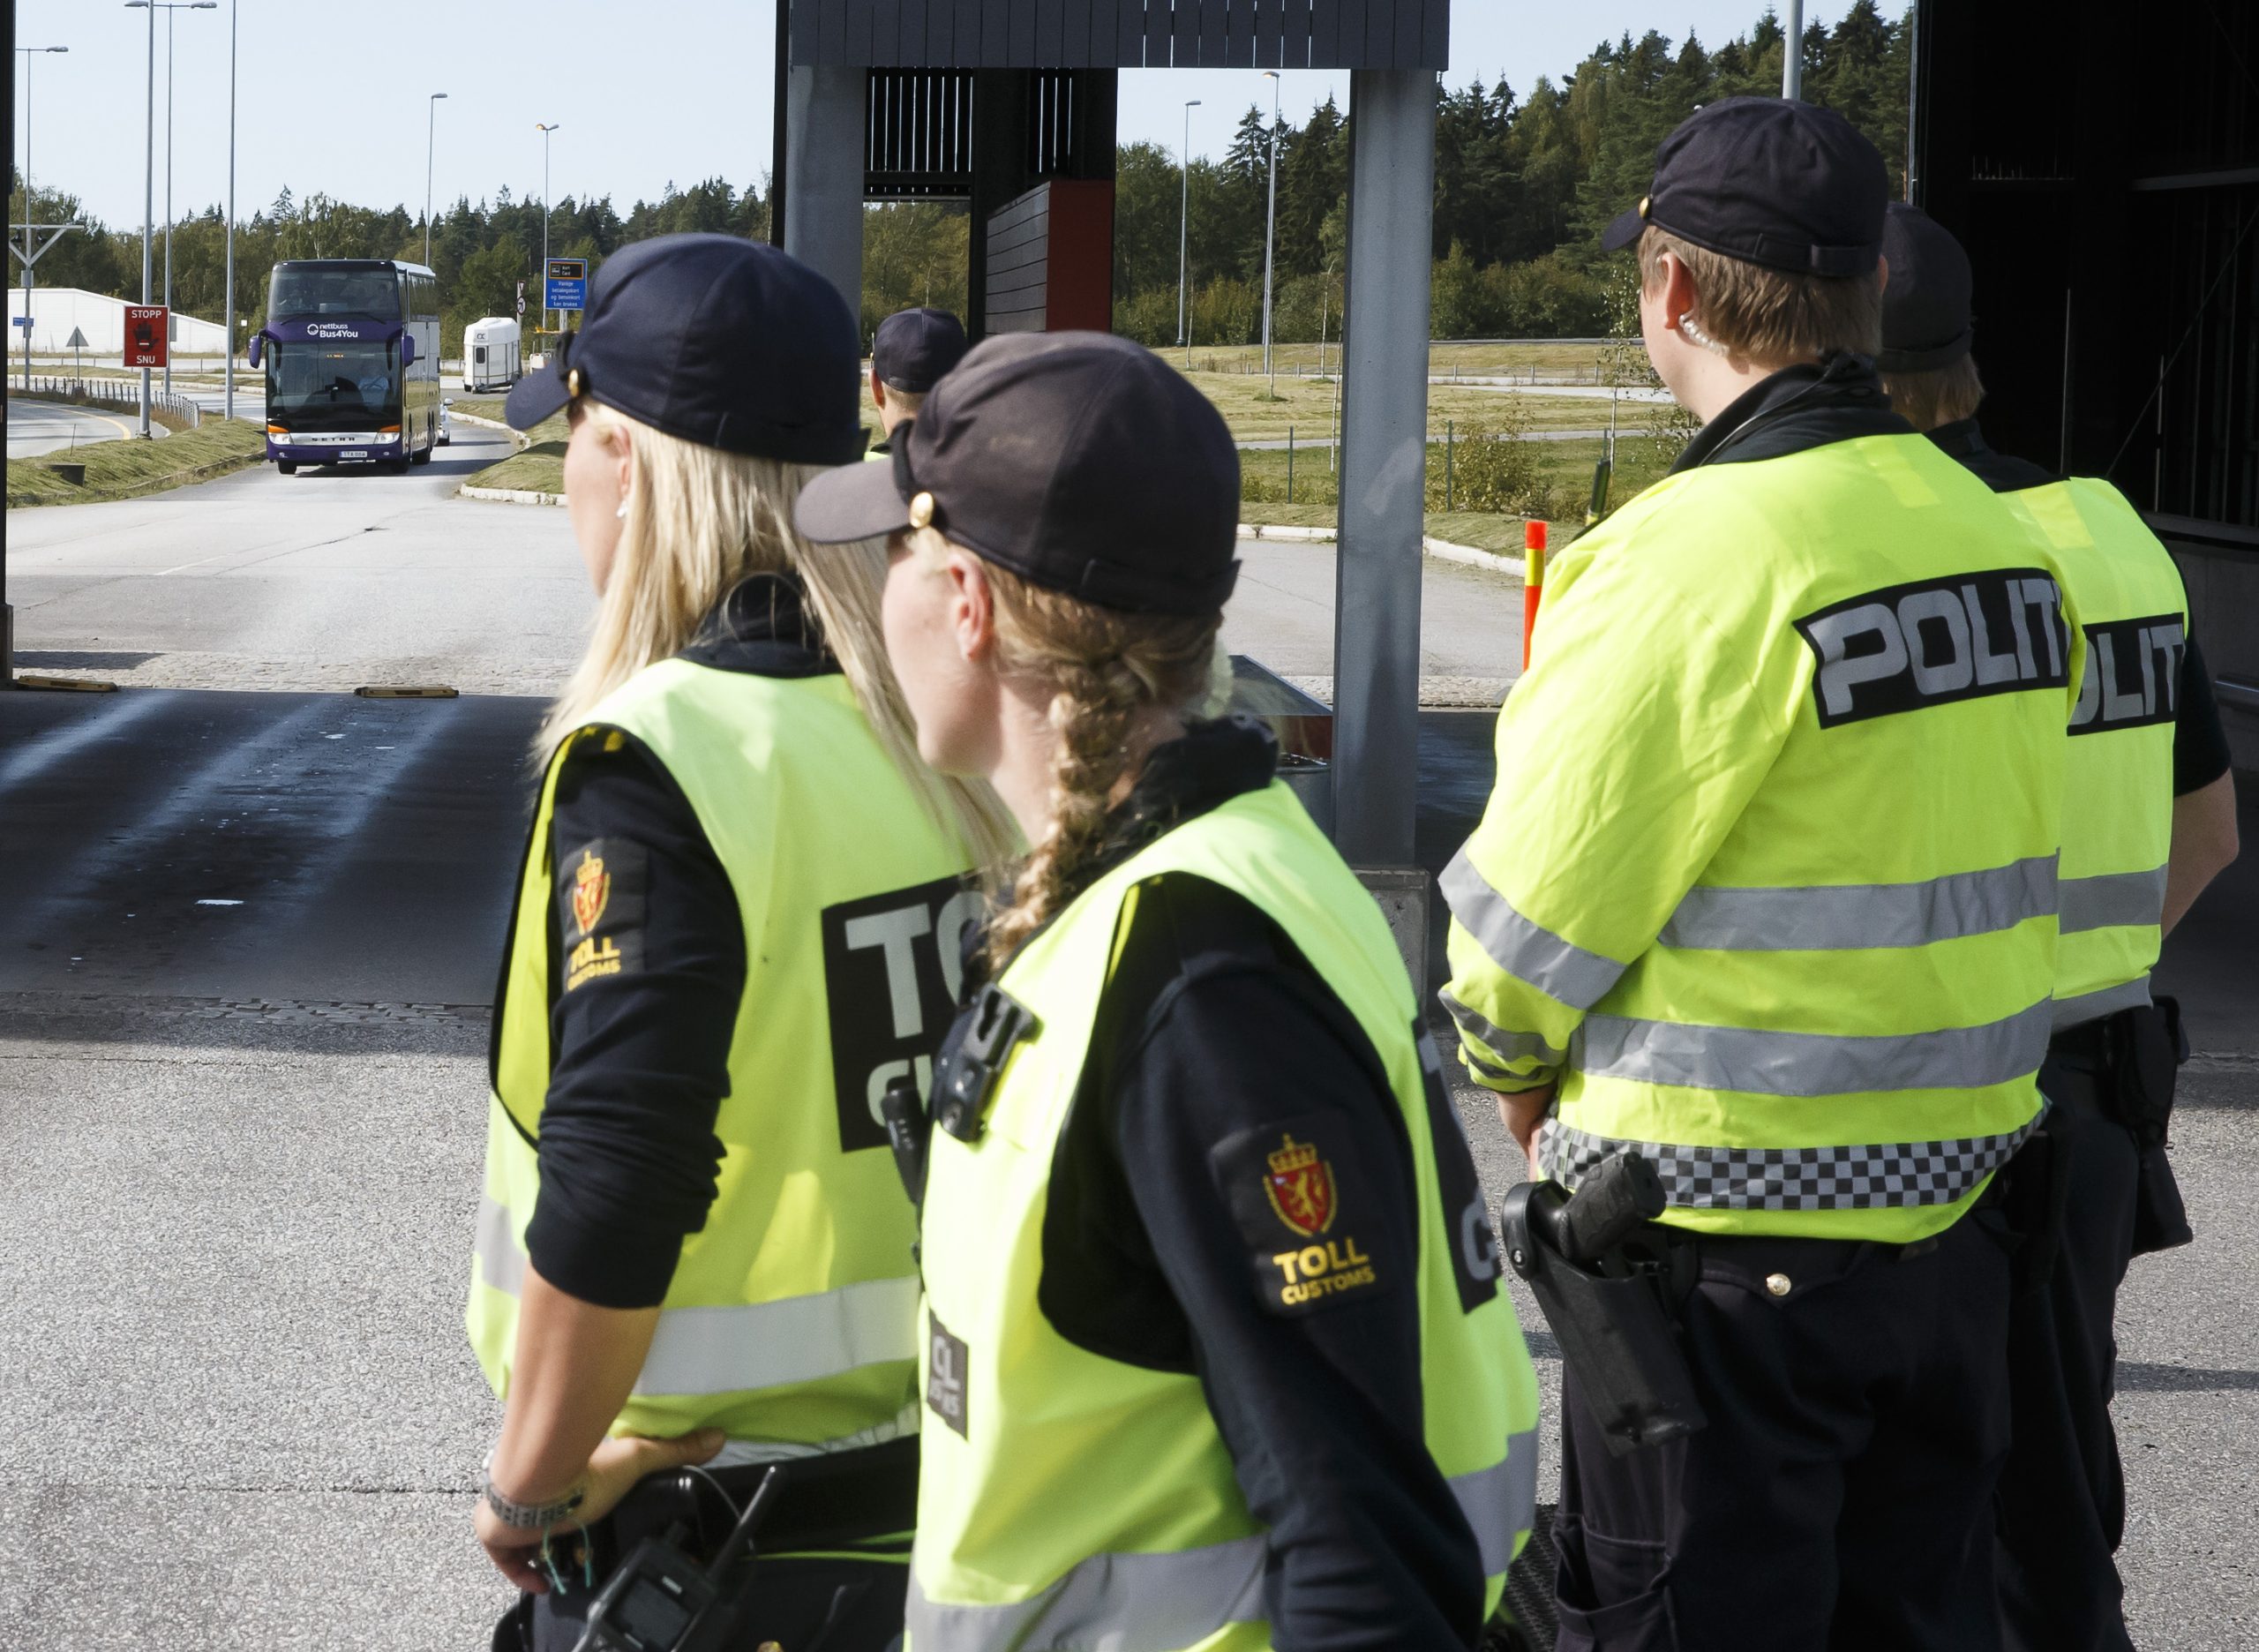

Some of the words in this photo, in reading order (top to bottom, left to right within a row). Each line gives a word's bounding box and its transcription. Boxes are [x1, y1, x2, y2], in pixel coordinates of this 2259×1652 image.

[131, 310, 161, 319] STOPP
[136, 355, 155, 364] SNU
[1806, 578, 2072, 716] POLIT
[1272, 1236, 1370, 1285] TOLL
[1280, 1265, 1377, 1306] CUSTOMS
